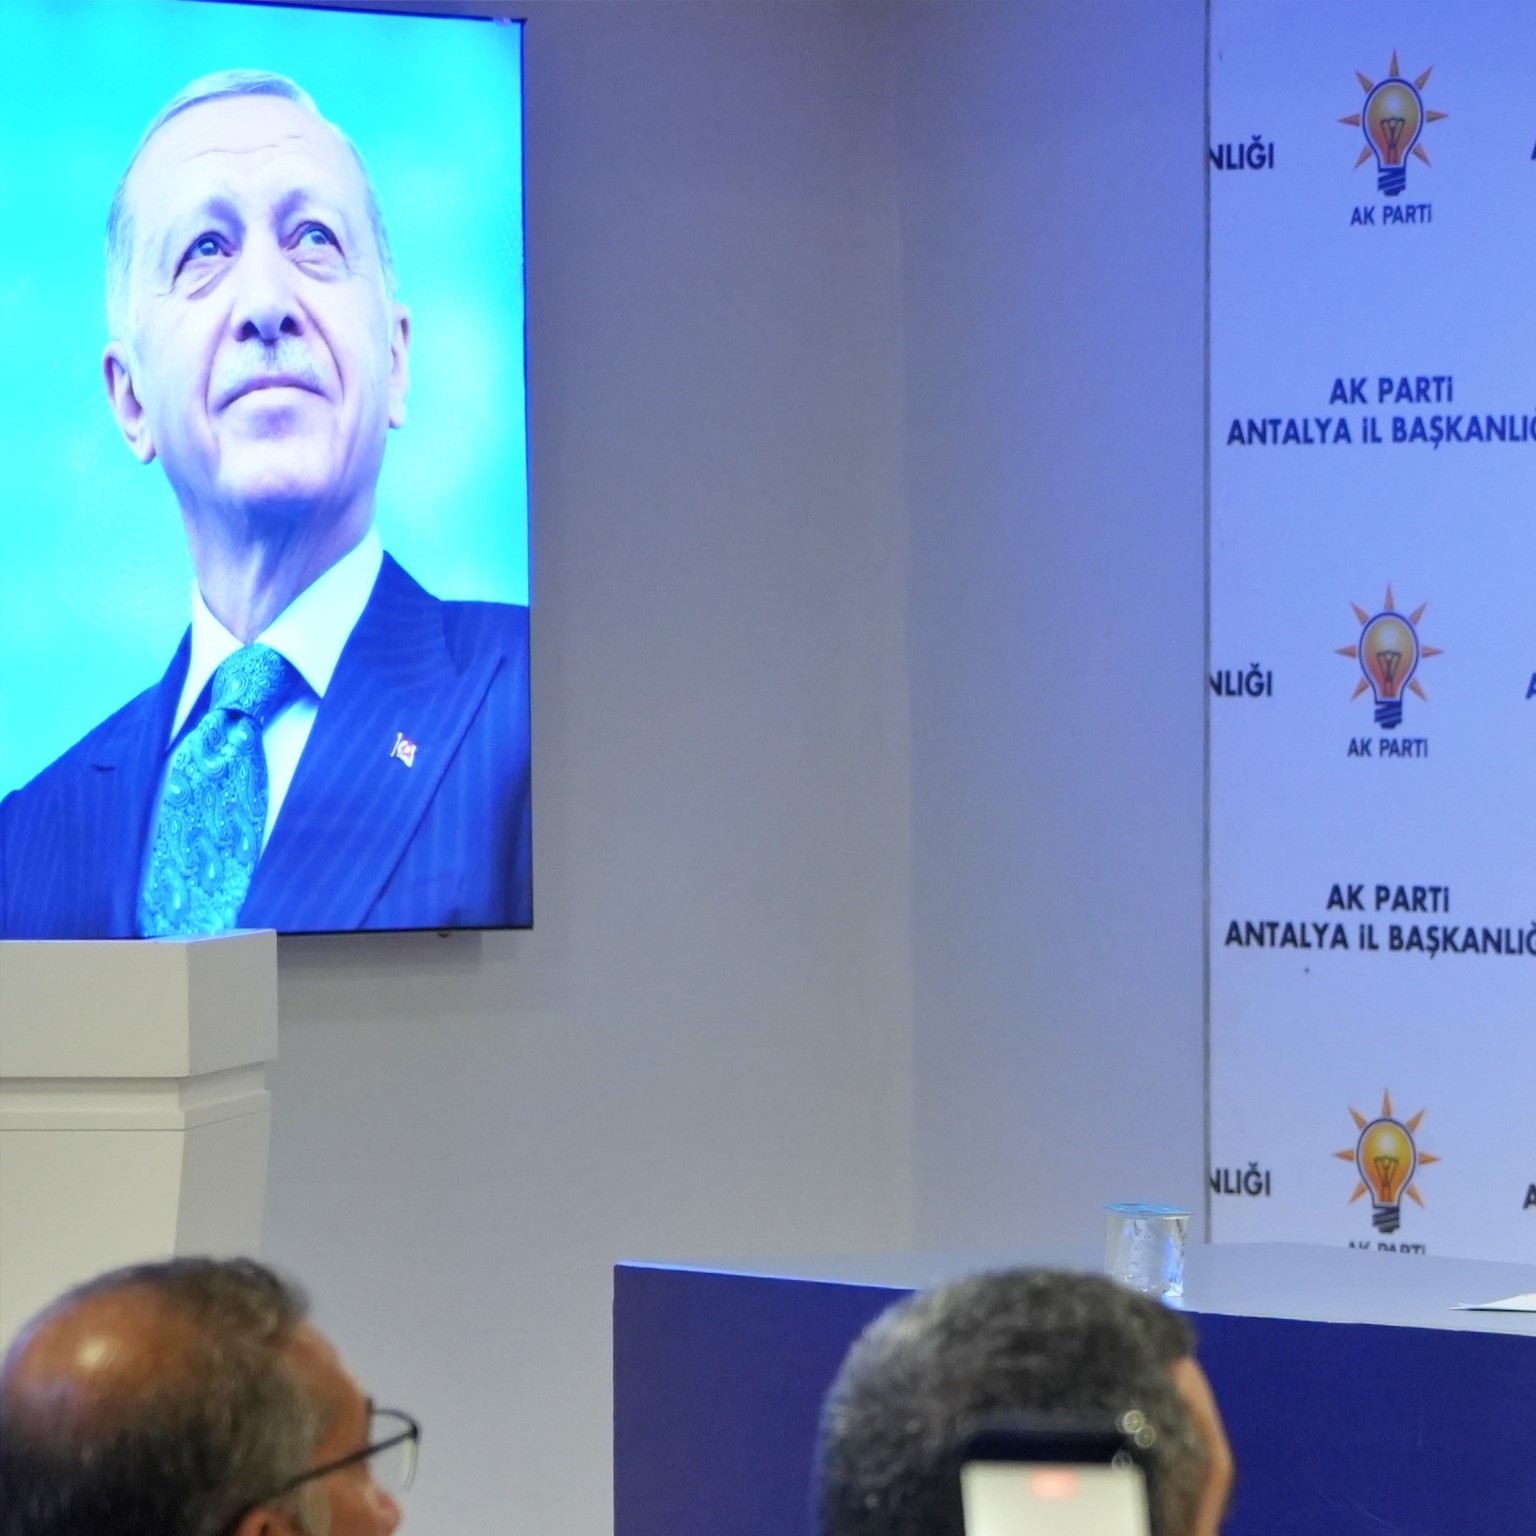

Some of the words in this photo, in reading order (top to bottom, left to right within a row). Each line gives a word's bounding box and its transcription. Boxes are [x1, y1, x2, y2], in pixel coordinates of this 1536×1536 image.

[1351, 206, 1375, 225] AK
[1330, 378, 1367, 404] AK
[1227, 418, 1351, 445] ANTALYA
[1348, 738, 1371, 757] AK
[1327, 884, 1364, 910] AK
[1225, 921, 1348, 949] ANTALYA
